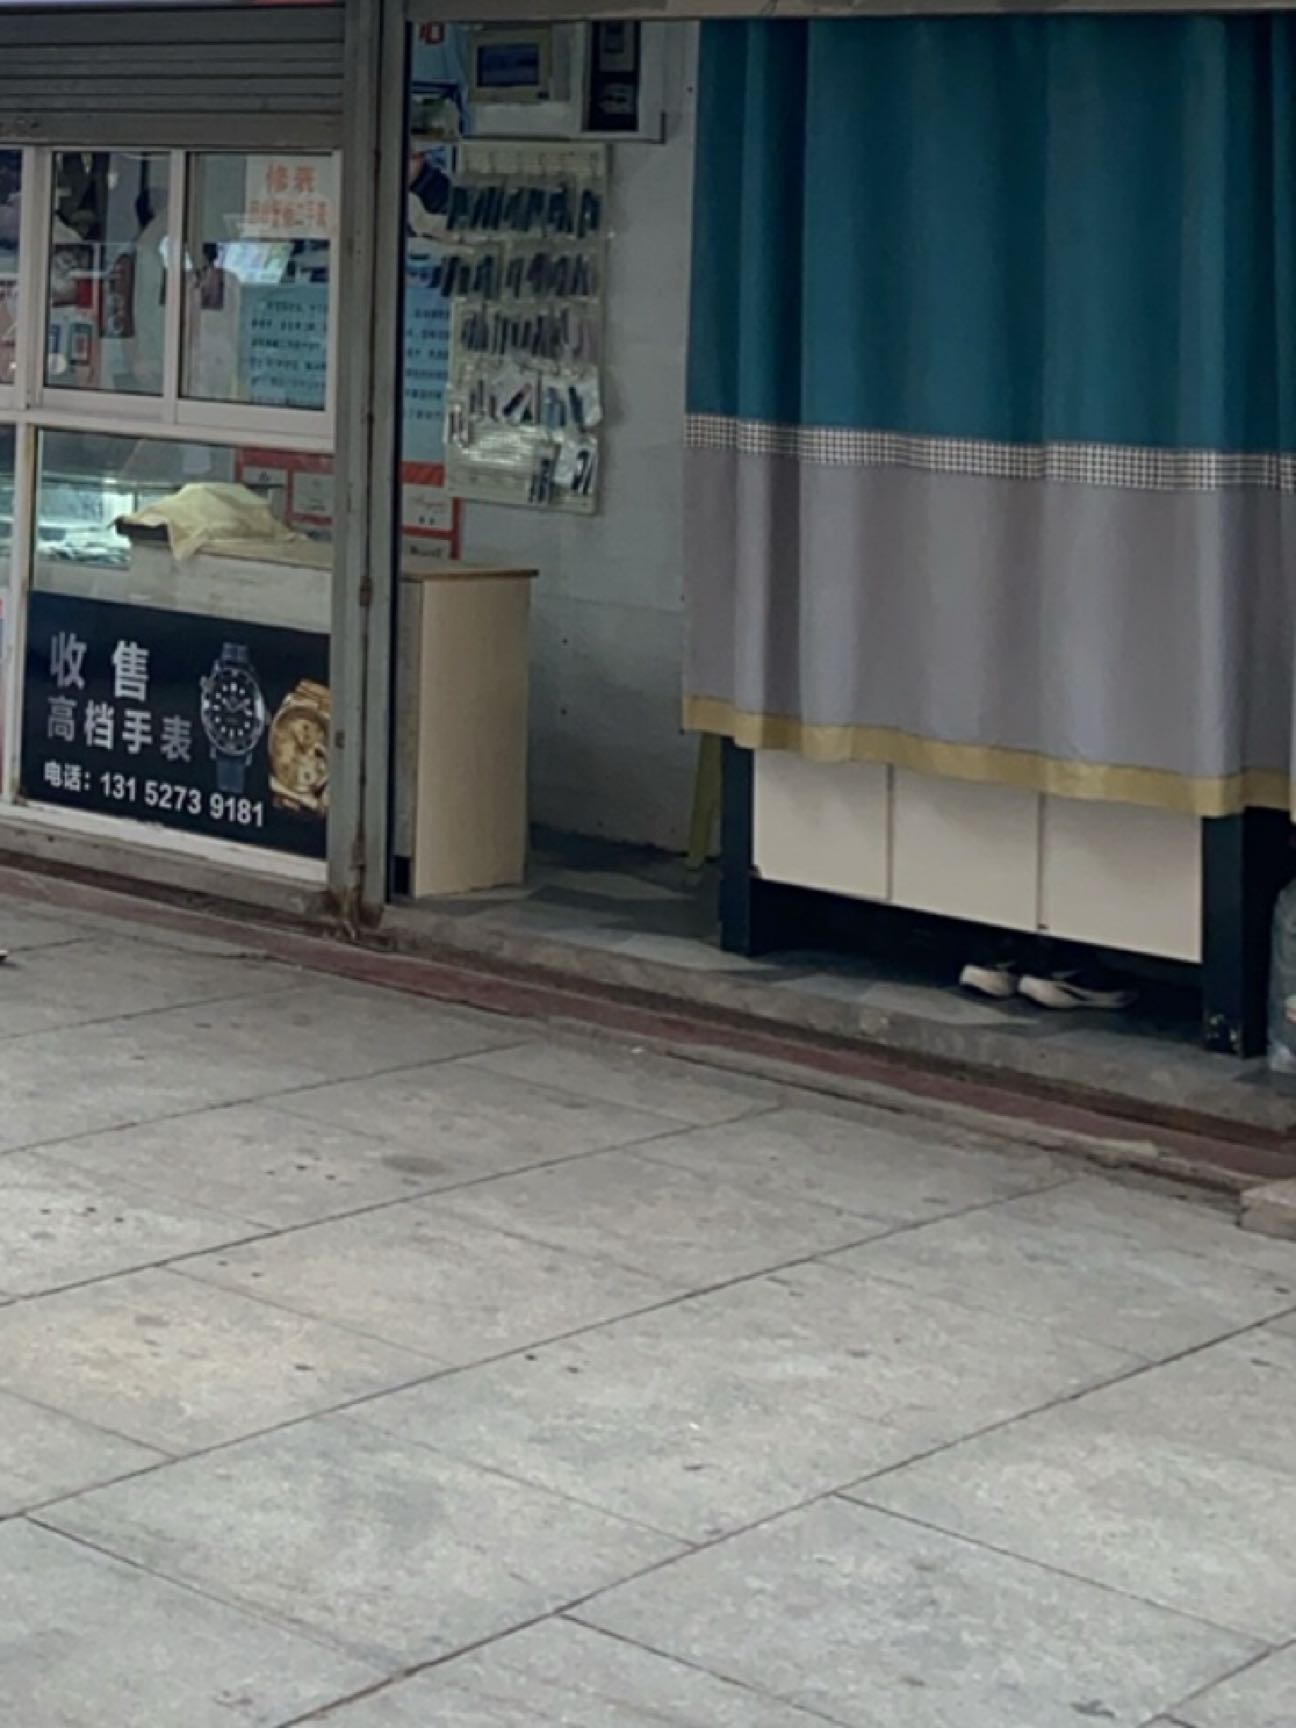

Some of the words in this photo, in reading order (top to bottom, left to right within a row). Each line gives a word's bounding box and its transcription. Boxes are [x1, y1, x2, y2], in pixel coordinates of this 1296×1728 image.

[50, 632, 150, 702] 收售
[47, 696, 193, 763] 高档手表
[101, 772, 136, 802] 131
[144, 780, 202, 815] 5273
[210, 793, 263, 827] 9181
